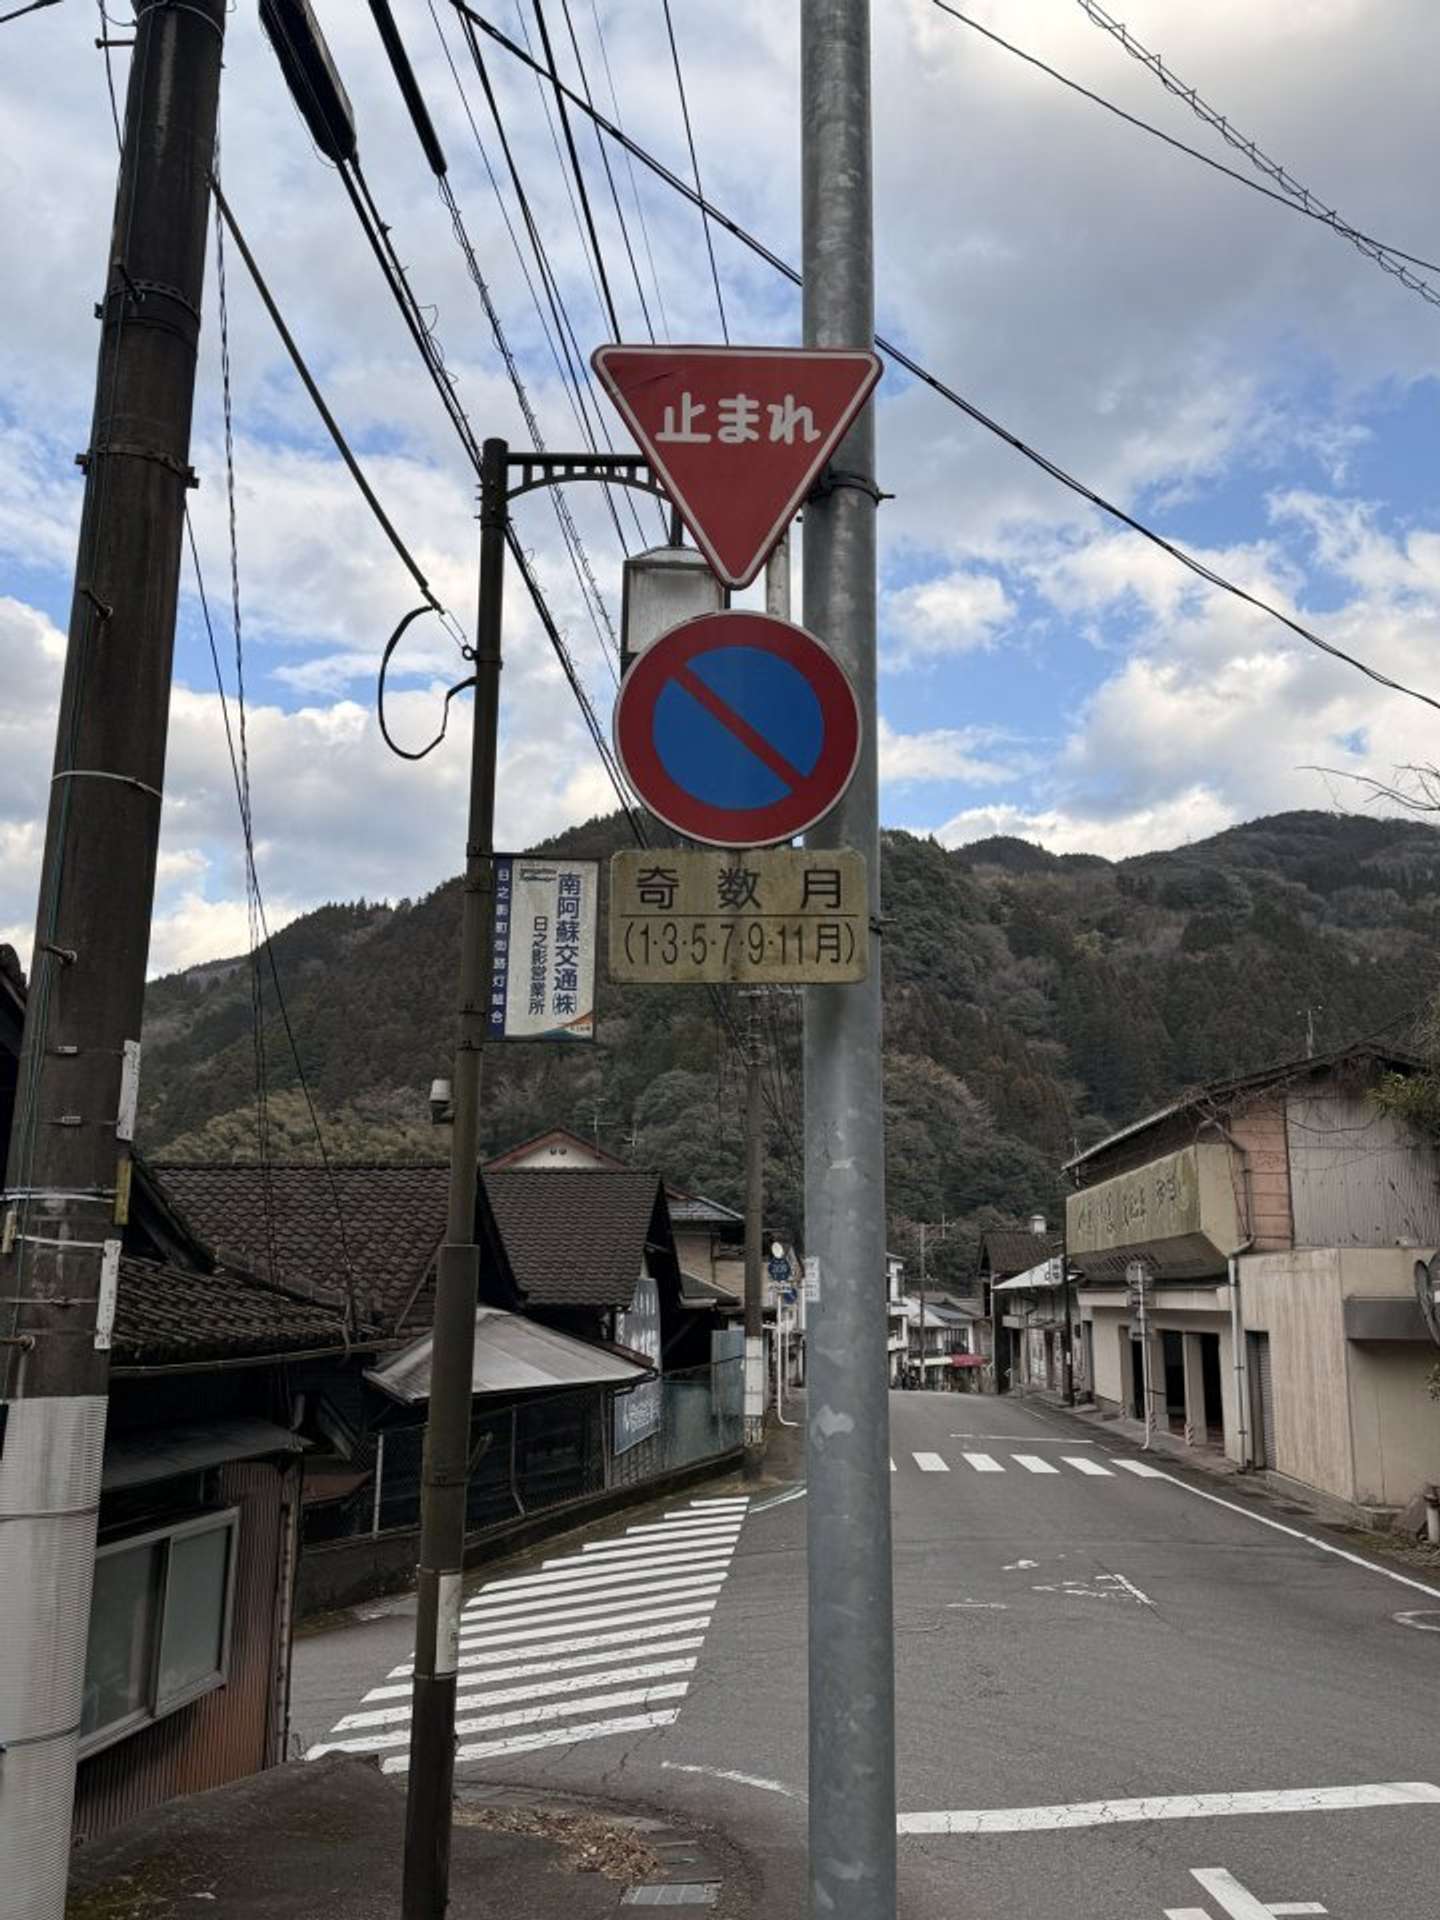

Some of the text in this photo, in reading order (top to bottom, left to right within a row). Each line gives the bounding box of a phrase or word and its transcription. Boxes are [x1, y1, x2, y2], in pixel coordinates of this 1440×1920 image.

[655, 391, 821, 444] 止まれ
[636, 866, 842, 910] 奇数月
